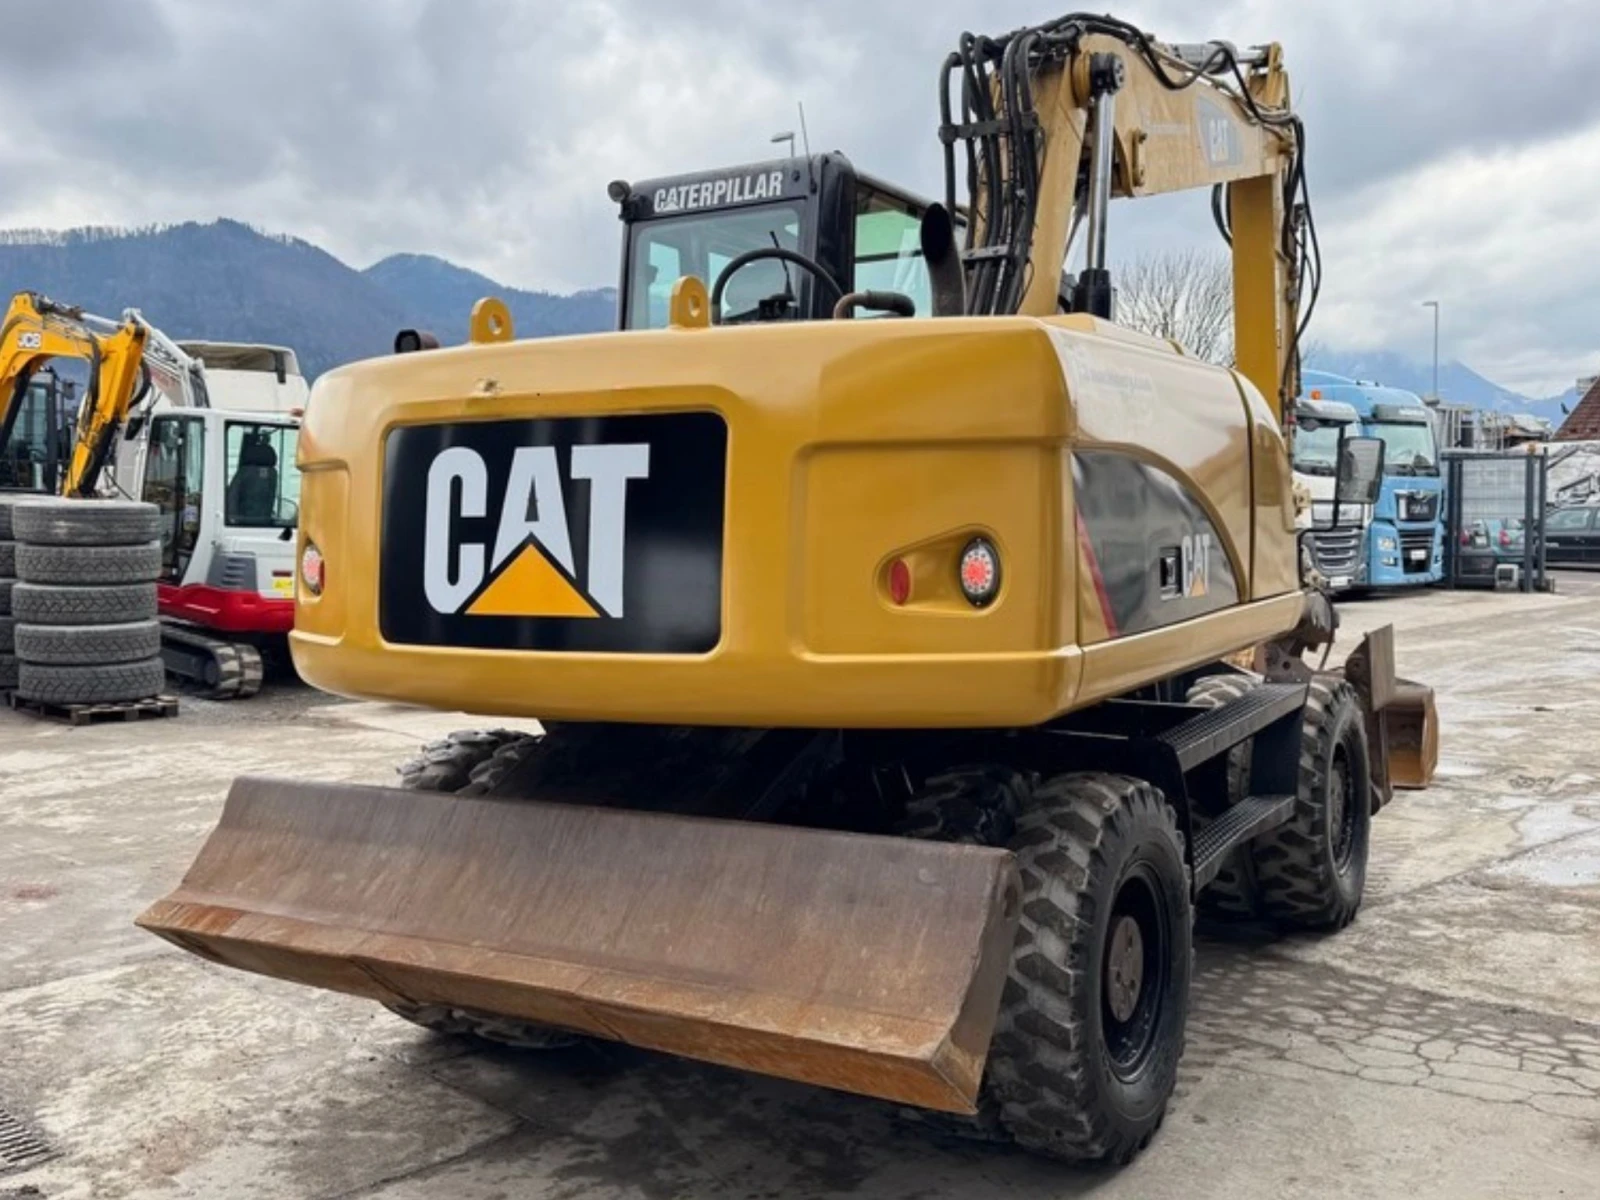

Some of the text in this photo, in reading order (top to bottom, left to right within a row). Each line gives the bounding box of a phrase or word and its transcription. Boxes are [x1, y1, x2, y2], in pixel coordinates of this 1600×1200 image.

[1208, 119, 1229, 162] CAT
[653, 171, 783, 213] CATERPILLAR
[423, 443, 650, 618] CAT
[1181, 533, 1211, 599] CAT
